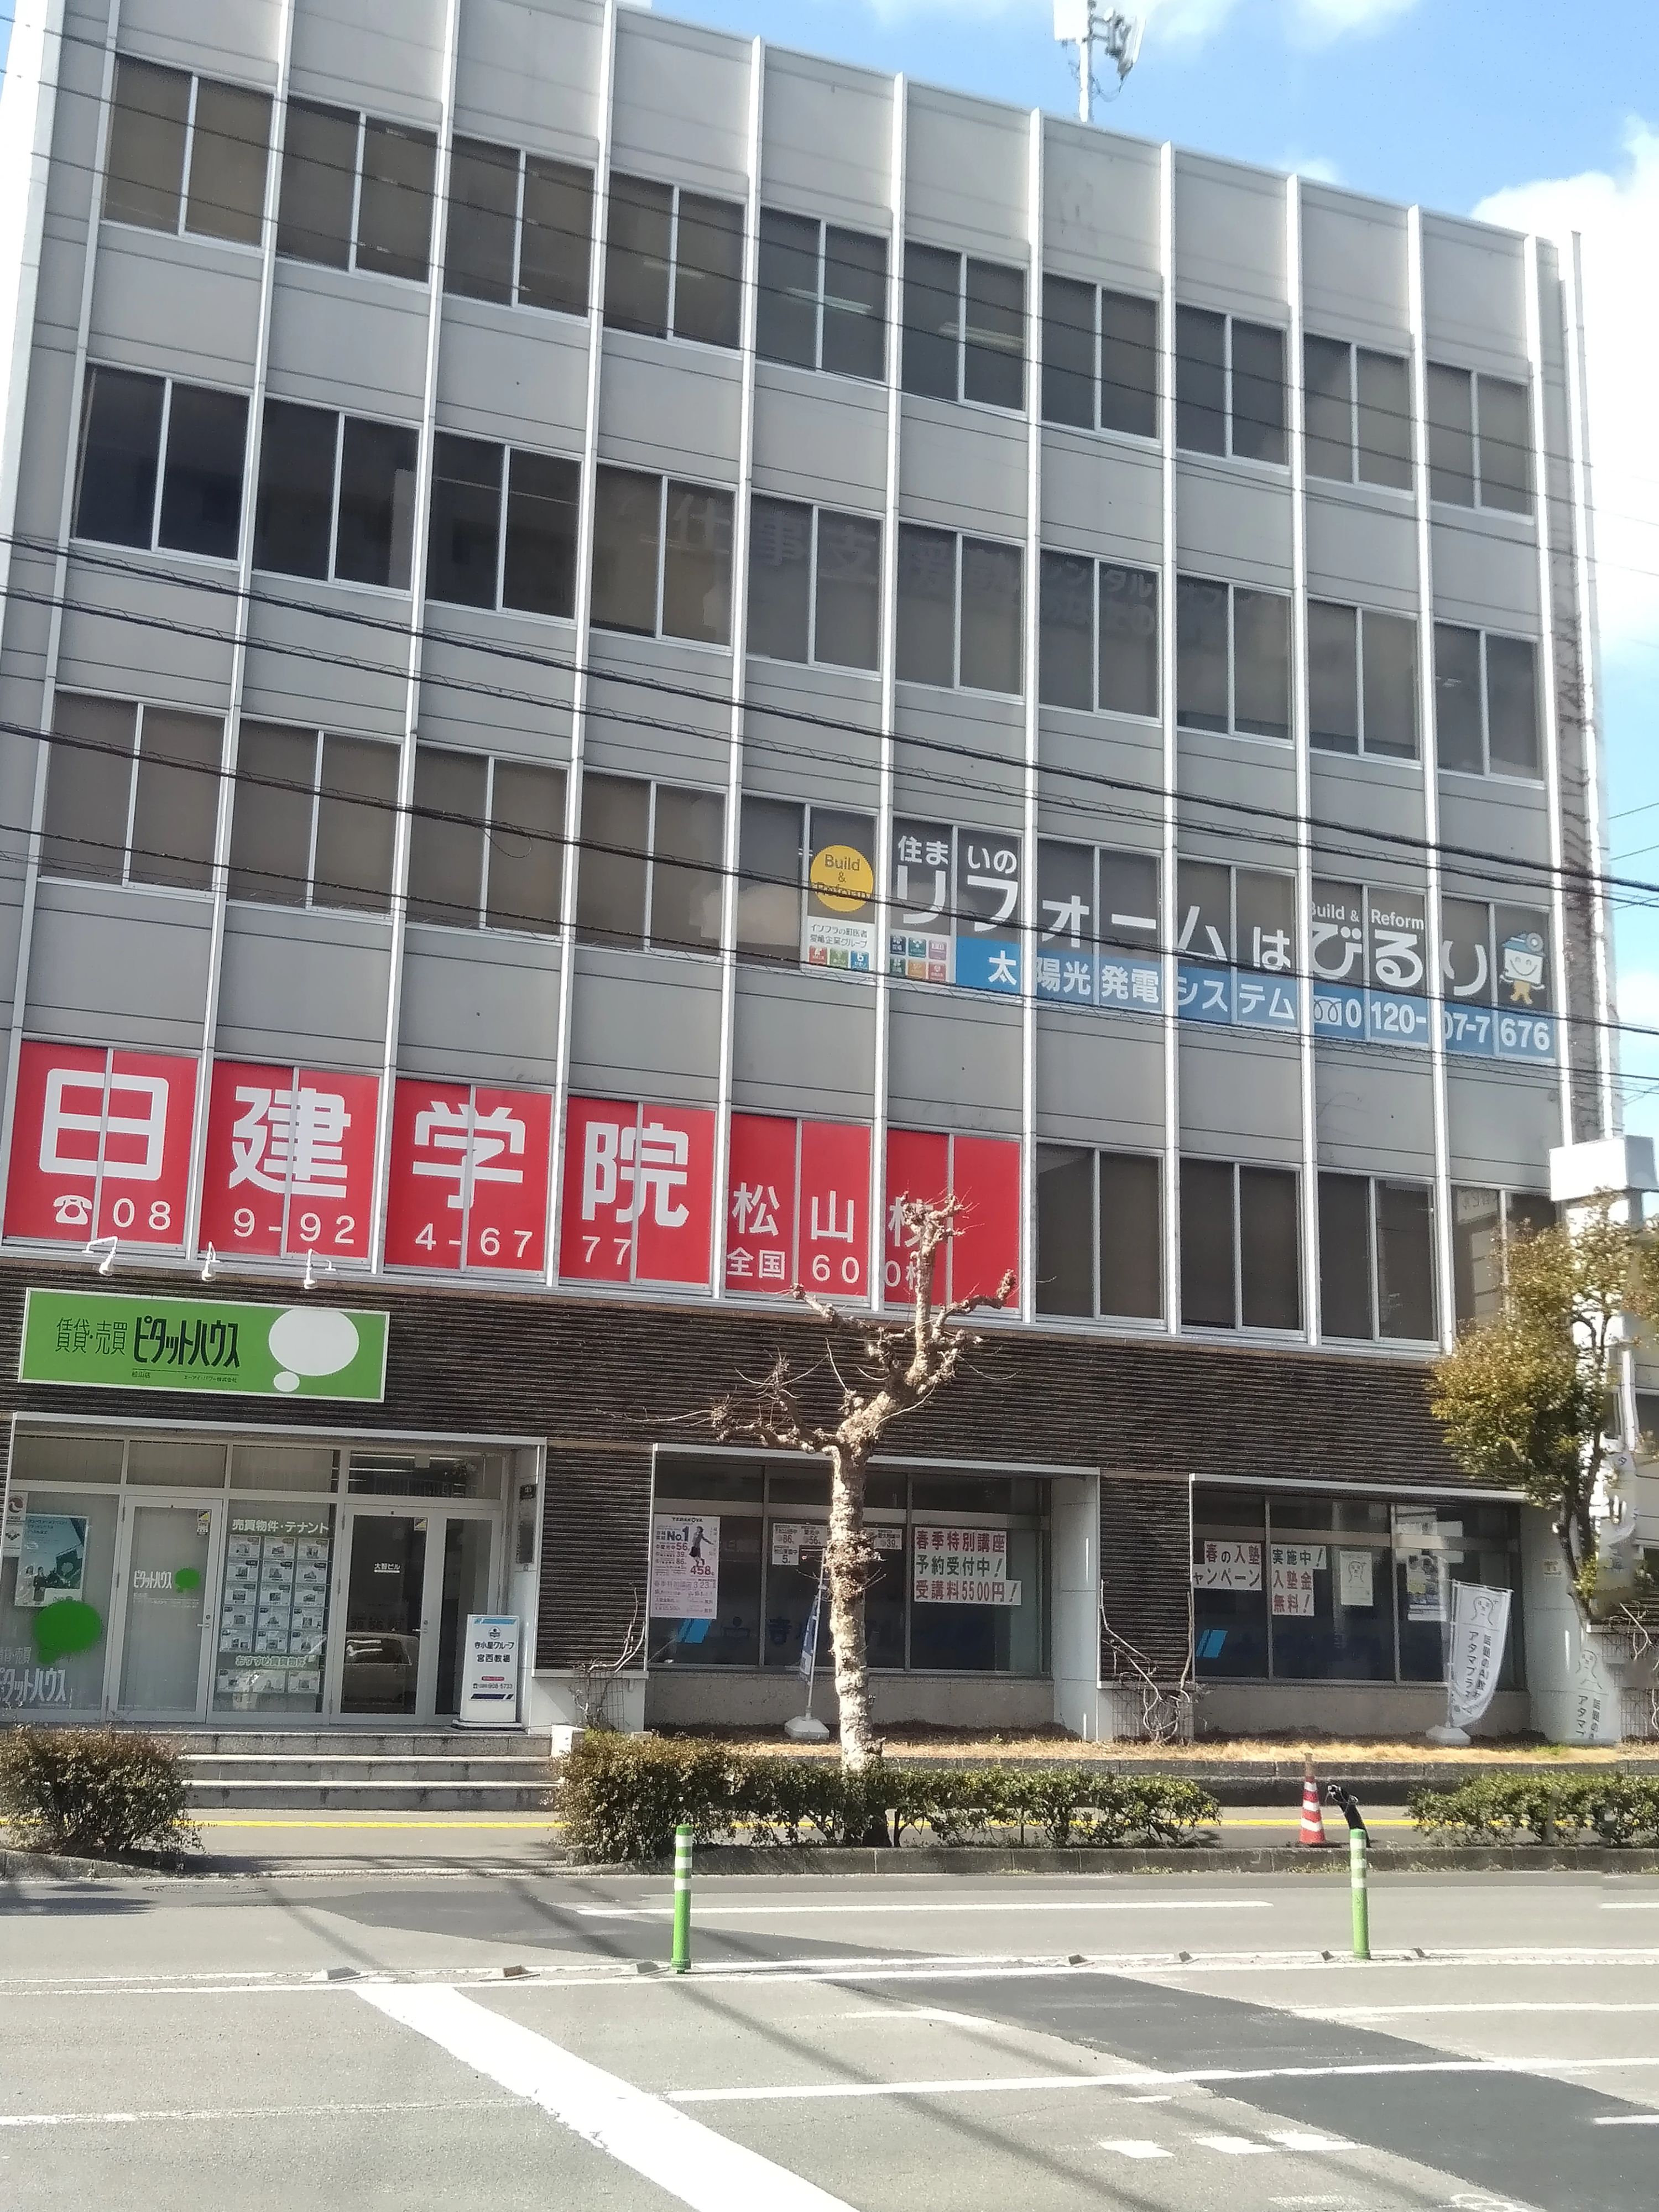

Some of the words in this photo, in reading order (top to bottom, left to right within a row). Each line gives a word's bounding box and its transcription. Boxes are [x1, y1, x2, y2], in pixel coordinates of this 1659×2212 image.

[825, 854, 860, 871] Build
[898, 836, 1017, 874] 住まいの
[838, 871, 846, 883] &
[1350, 910, 1360, 922] &
[1371, 909, 1424, 930] Reform
[39, 1068, 690, 1227] 日建学院
[133, 1315, 241, 1368] ピタットハウス
[916, 1530, 1005, 1553] 春季特別講座
[1206, 1543, 1260, 1565] 春の入塾
[133, 1569, 172, 1589] ピタットハウス
[1273, 1569, 1312, 1590] 入塾金
